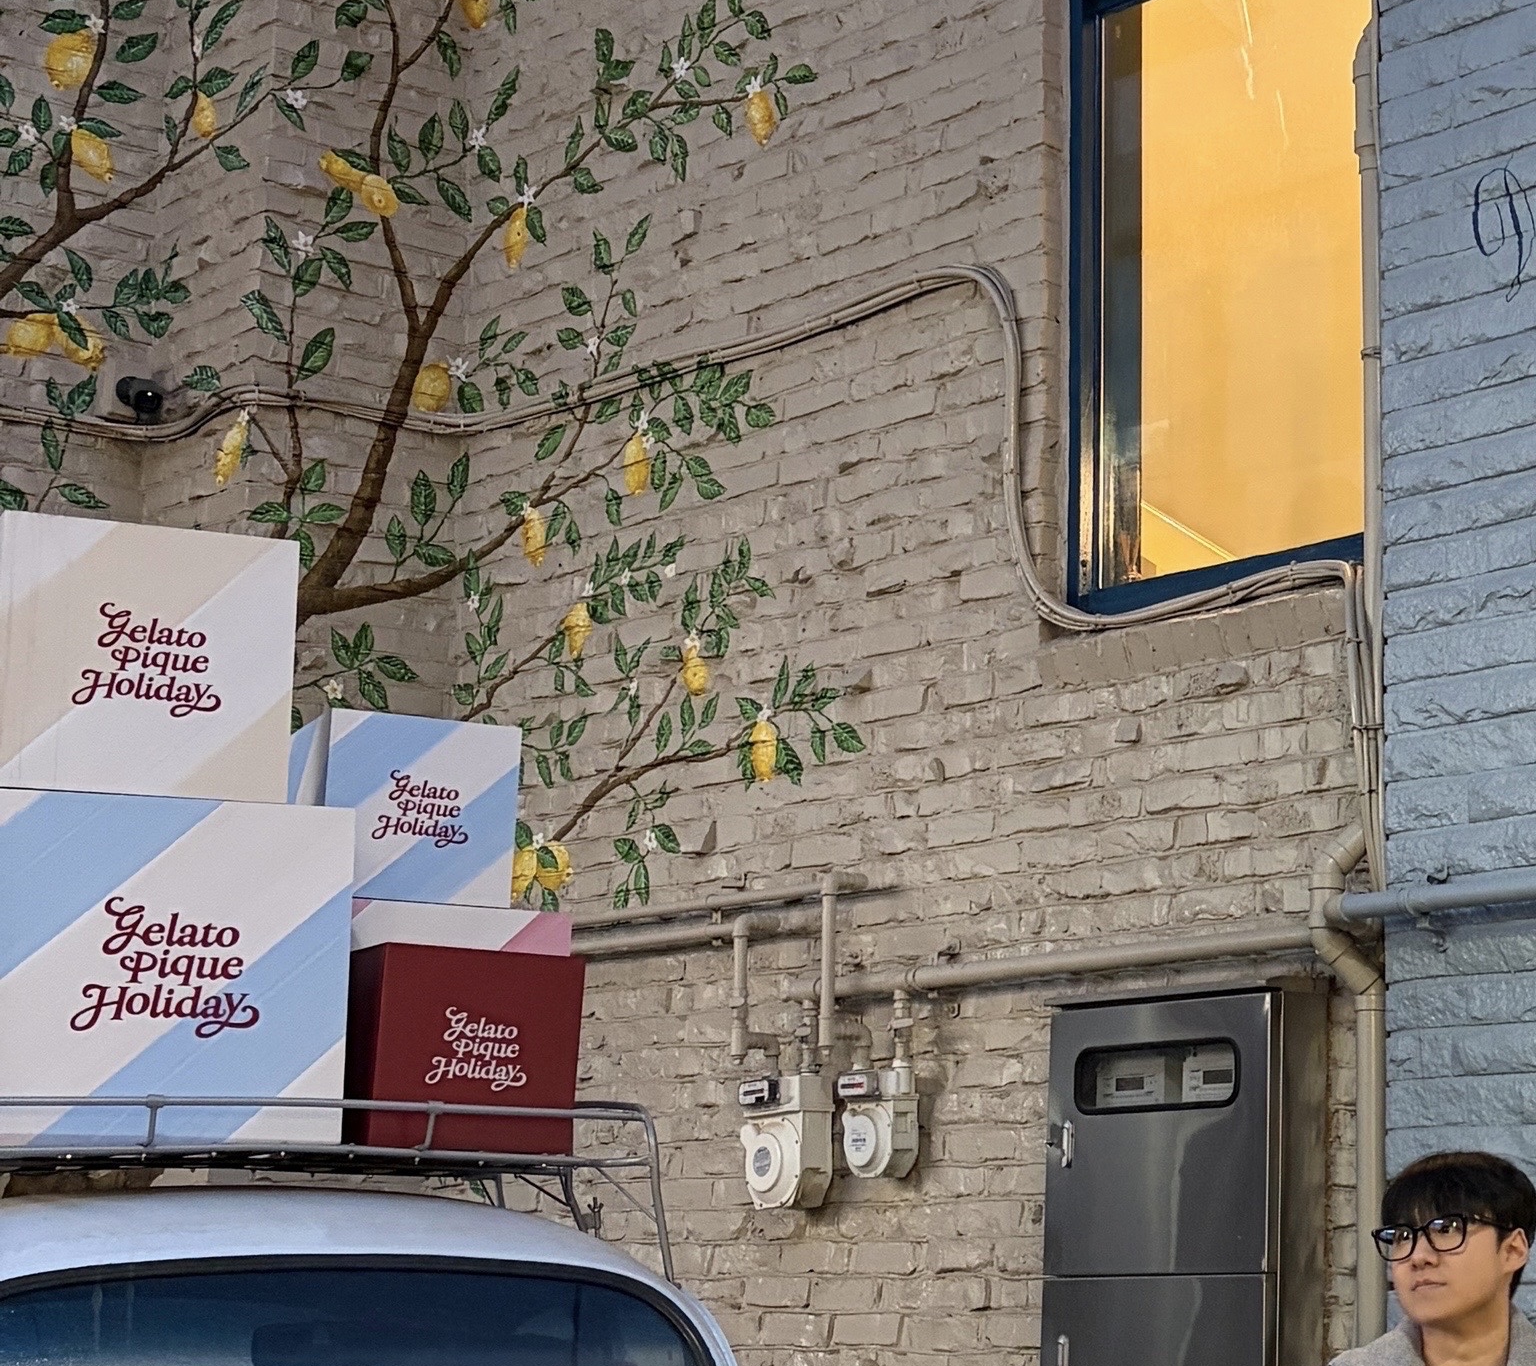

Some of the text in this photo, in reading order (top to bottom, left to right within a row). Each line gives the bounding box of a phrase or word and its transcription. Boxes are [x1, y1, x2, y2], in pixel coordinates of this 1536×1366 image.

[97, 602, 207, 649] Gelato
[111, 645, 209, 675] Pique
[71, 669, 221, 718] Holiday
[388, 769, 460, 801] Gelato
[397, 798, 461, 820] Pique
[371, 815, 468, 848] Holiday
[101, 896, 240, 954] Gelato
[120, 950, 244, 985] Pique
[69, 984, 260, 1039] Holiday
[443, 1006, 518, 1041] Gelato
[452, 1037, 520, 1060] Pique
[424, 1056, 527, 1092] Holiday
